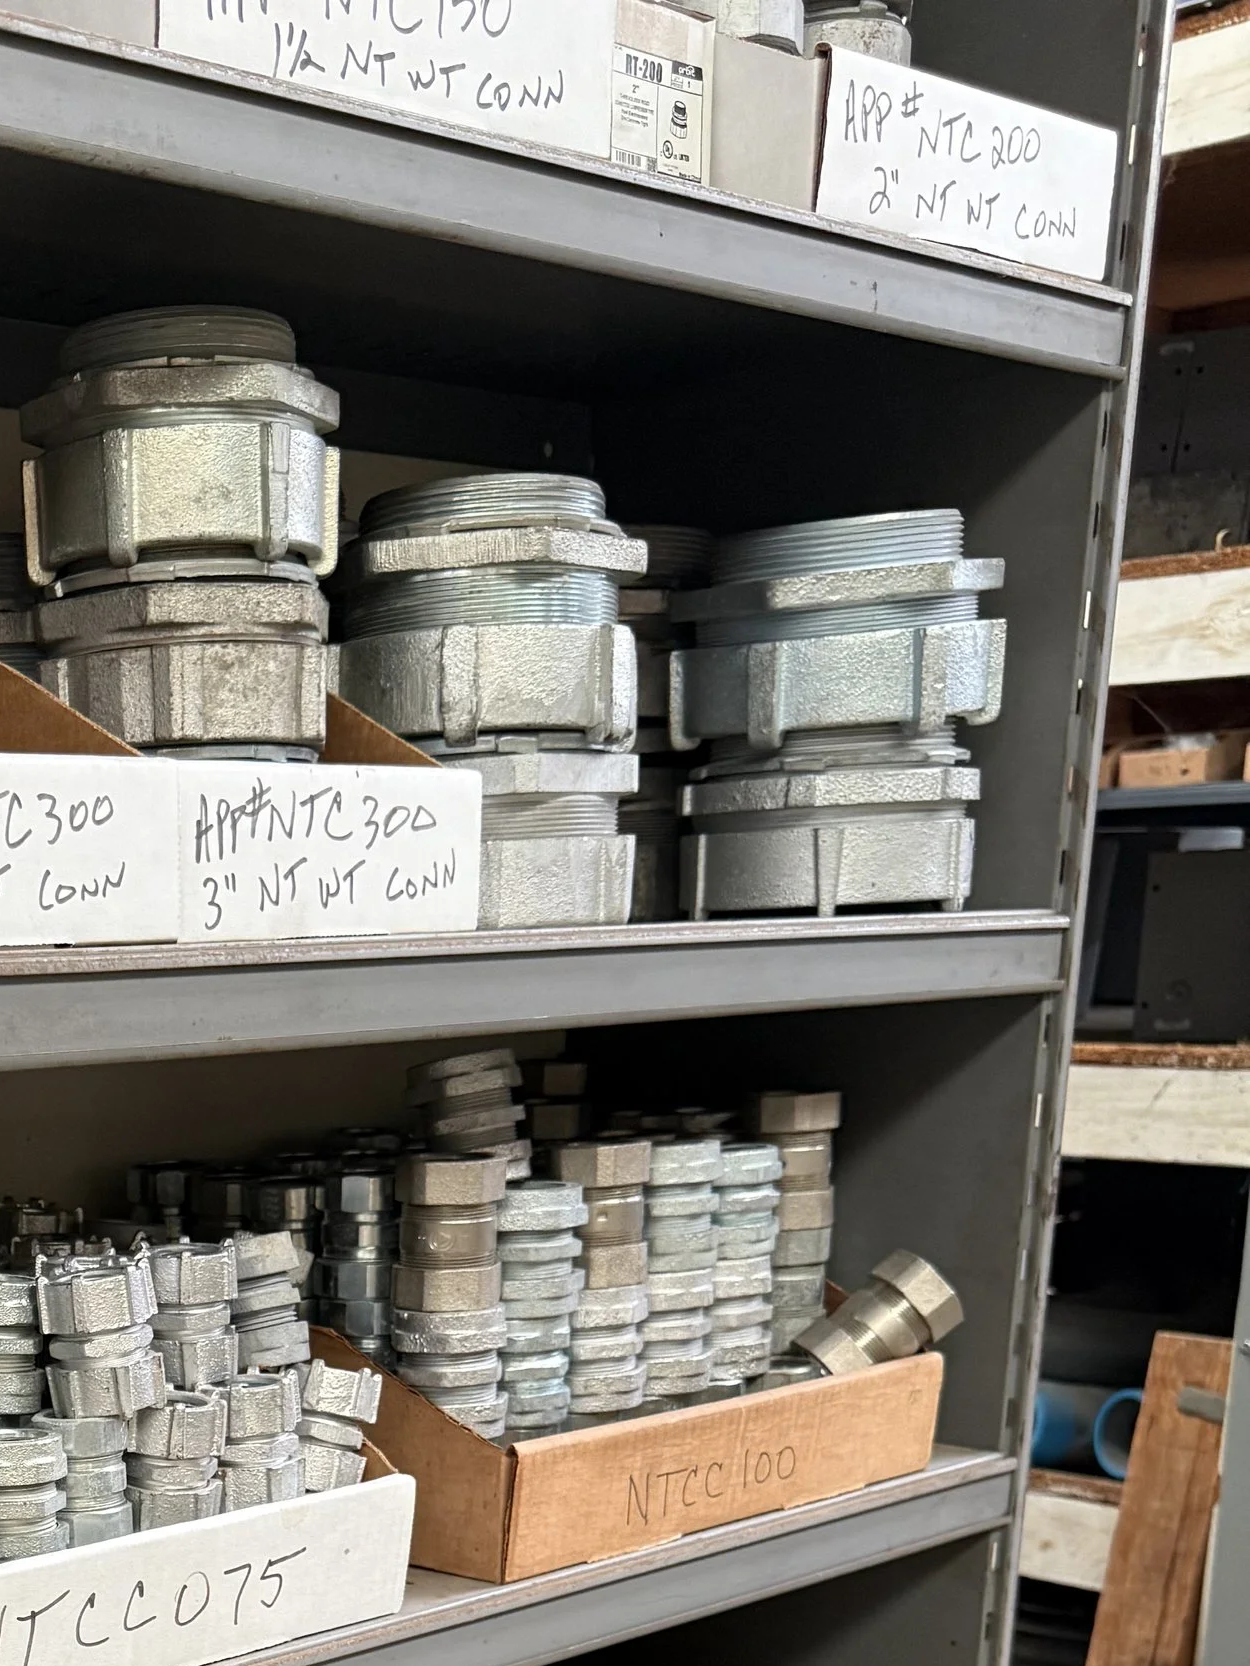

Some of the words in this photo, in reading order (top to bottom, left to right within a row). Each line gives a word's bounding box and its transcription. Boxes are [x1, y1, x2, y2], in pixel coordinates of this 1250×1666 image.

[340, 40, 396, 87] NT
[407, 59, 466, 98] WT
[476, 69, 567, 111] CONN
[625, 53, 663, 83] RT-200
[915, 180, 957, 222] NT
[1014, 203, 1076, 239] CONN
[38, 861, 126, 911] CONN
[259, 856, 309, 914] NT
[317, 861, 366, 911] WT
[384, 847, 457, 903] CONN
